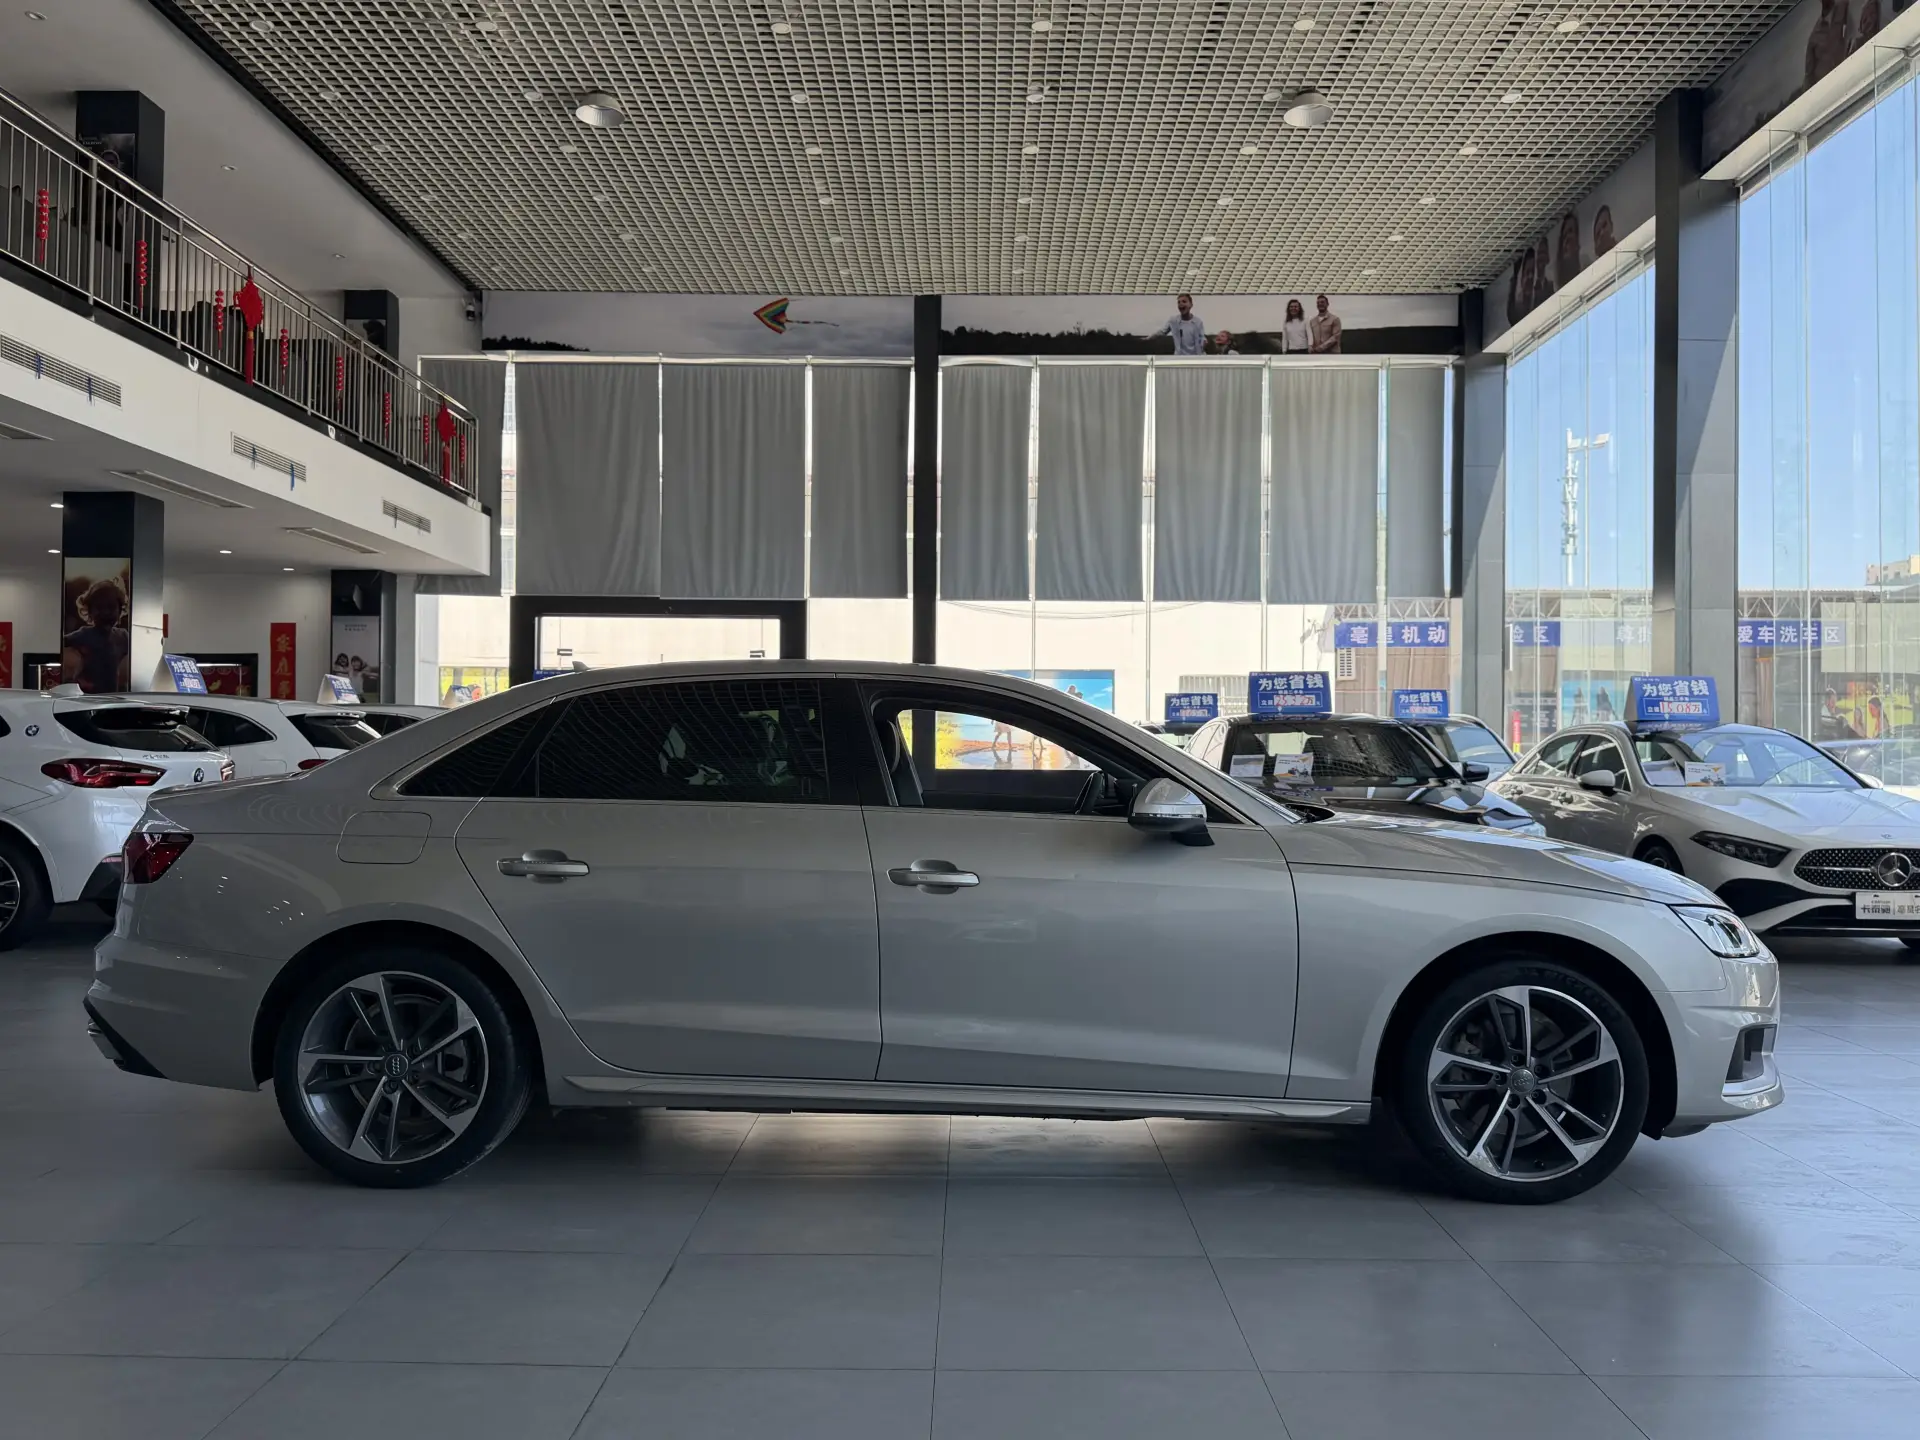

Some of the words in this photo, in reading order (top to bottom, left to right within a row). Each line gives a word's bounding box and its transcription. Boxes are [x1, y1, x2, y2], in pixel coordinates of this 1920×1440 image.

[1738, 625, 1840, 643] 爱车洗车区
[1259, 674, 1324, 691] 为您省钱
[1642, 680, 1710, 697] 为您省钱
[1170, 695, 1214, 707] 为您省钱
[1399, 691, 1443, 704] 为您省钱
